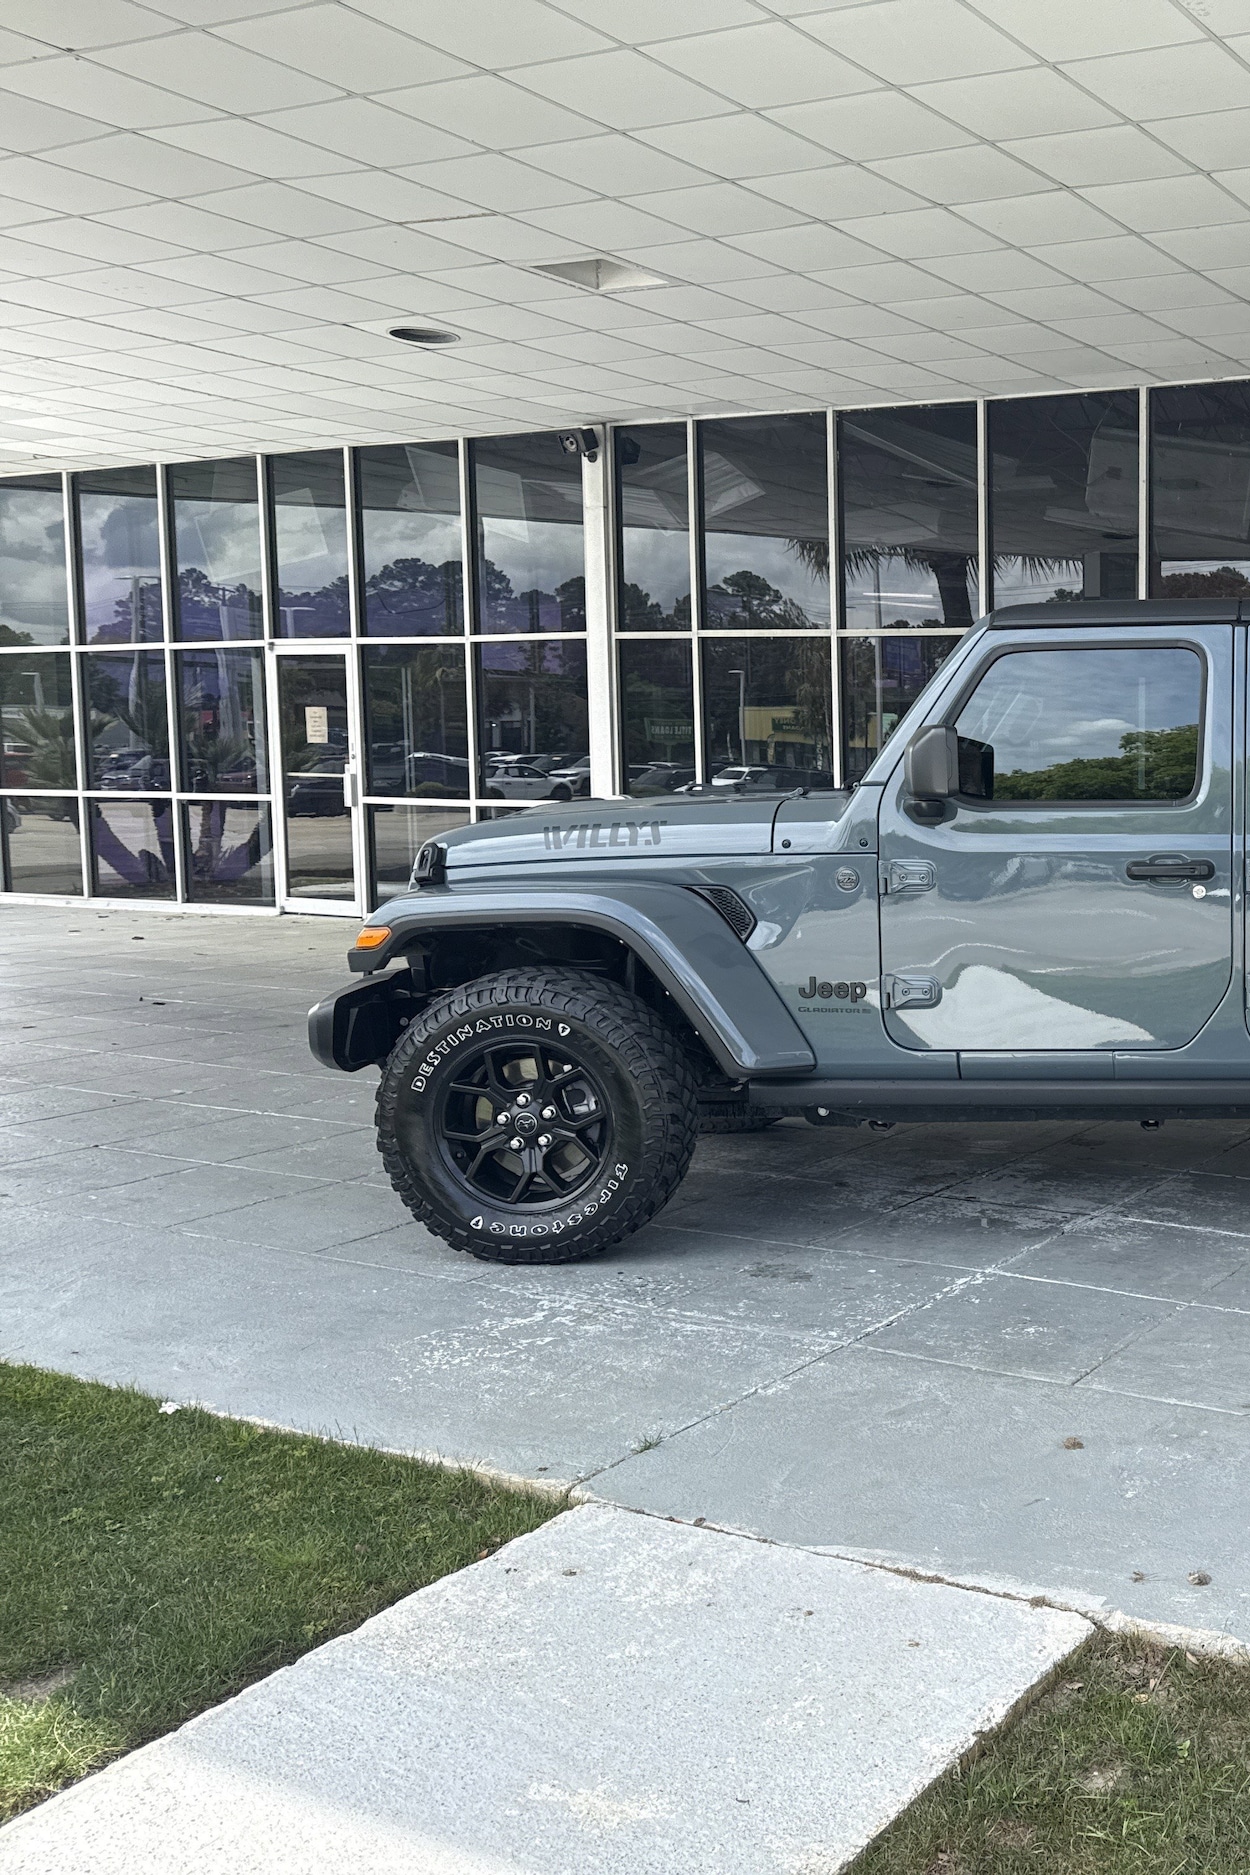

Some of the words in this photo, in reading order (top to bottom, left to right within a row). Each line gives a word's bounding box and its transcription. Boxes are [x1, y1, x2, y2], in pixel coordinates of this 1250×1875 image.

[543, 820, 668, 850] WILLYS
[798, 976, 867, 1003] Jeep
[798, 1006, 860, 1014] GLADIATOR
[412, 1013, 552, 1092] DESTINATION
[489, 1163, 629, 1237] Firestone
